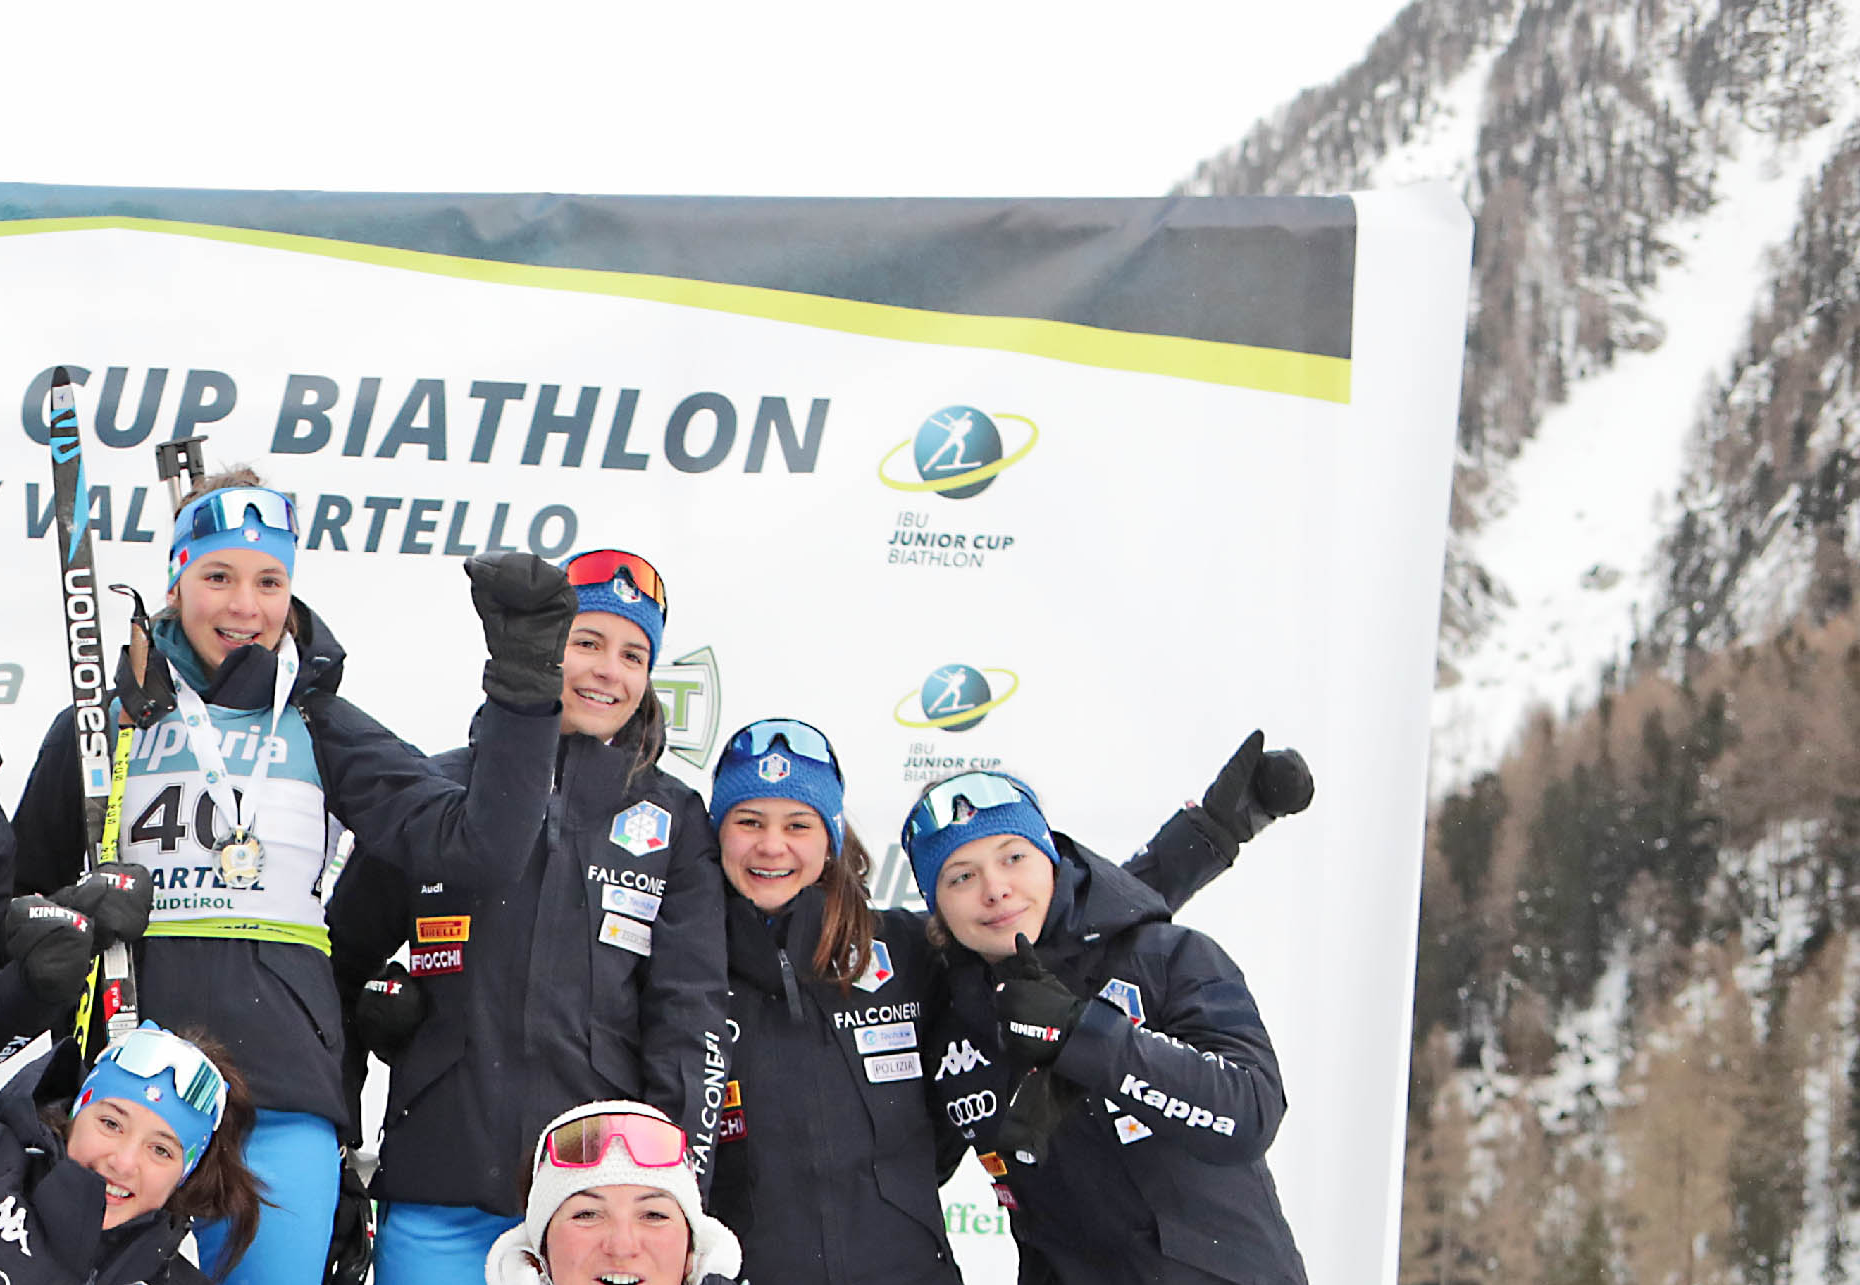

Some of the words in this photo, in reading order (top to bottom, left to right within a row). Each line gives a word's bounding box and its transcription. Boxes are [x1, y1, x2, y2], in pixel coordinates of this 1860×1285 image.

[21, 363, 238, 449] CUP
[270, 373, 830, 475] BIATHLON
[896, 511, 930, 528] IBU
[888, 530, 966, 549] JUNIOR
[973, 534, 1015, 551] CUP
[887, 549, 985, 568] BIATHLON
[908, 743, 936, 756] IBU
[903, 757, 965, 769] JUNIOR
[970, 758, 1002, 769] CUP
[420, 882, 443, 894] Audi
[411, 949, 461, 971] FIOCCHI
[874, 1060, 914, 1075] POLIZIA
[1119, 1073, 1237, 1137] Kappa
